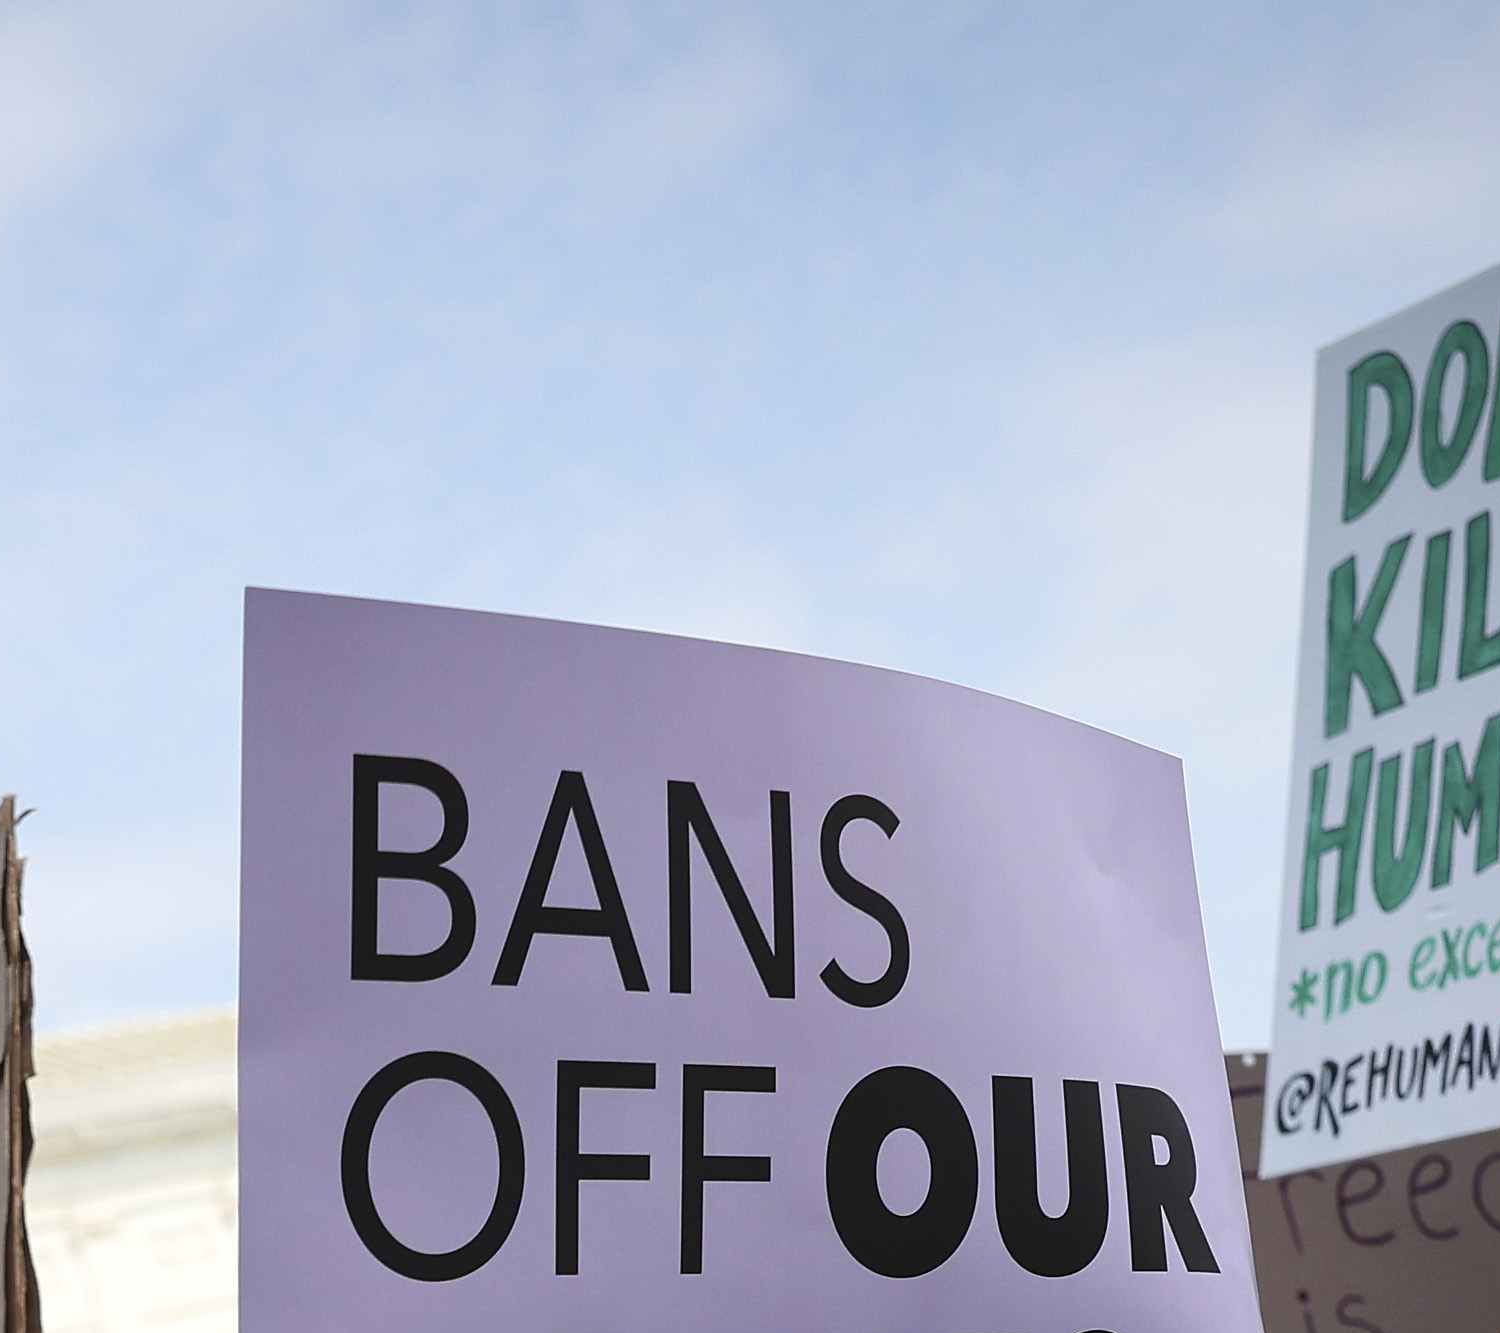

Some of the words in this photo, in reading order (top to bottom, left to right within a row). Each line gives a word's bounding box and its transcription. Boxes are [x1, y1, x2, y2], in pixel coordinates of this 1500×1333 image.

[350, 752, 911, 1009] BANS
[339, 1049, 777, 1282] OFF
[825, 1064, 1221, 1280] OUR
